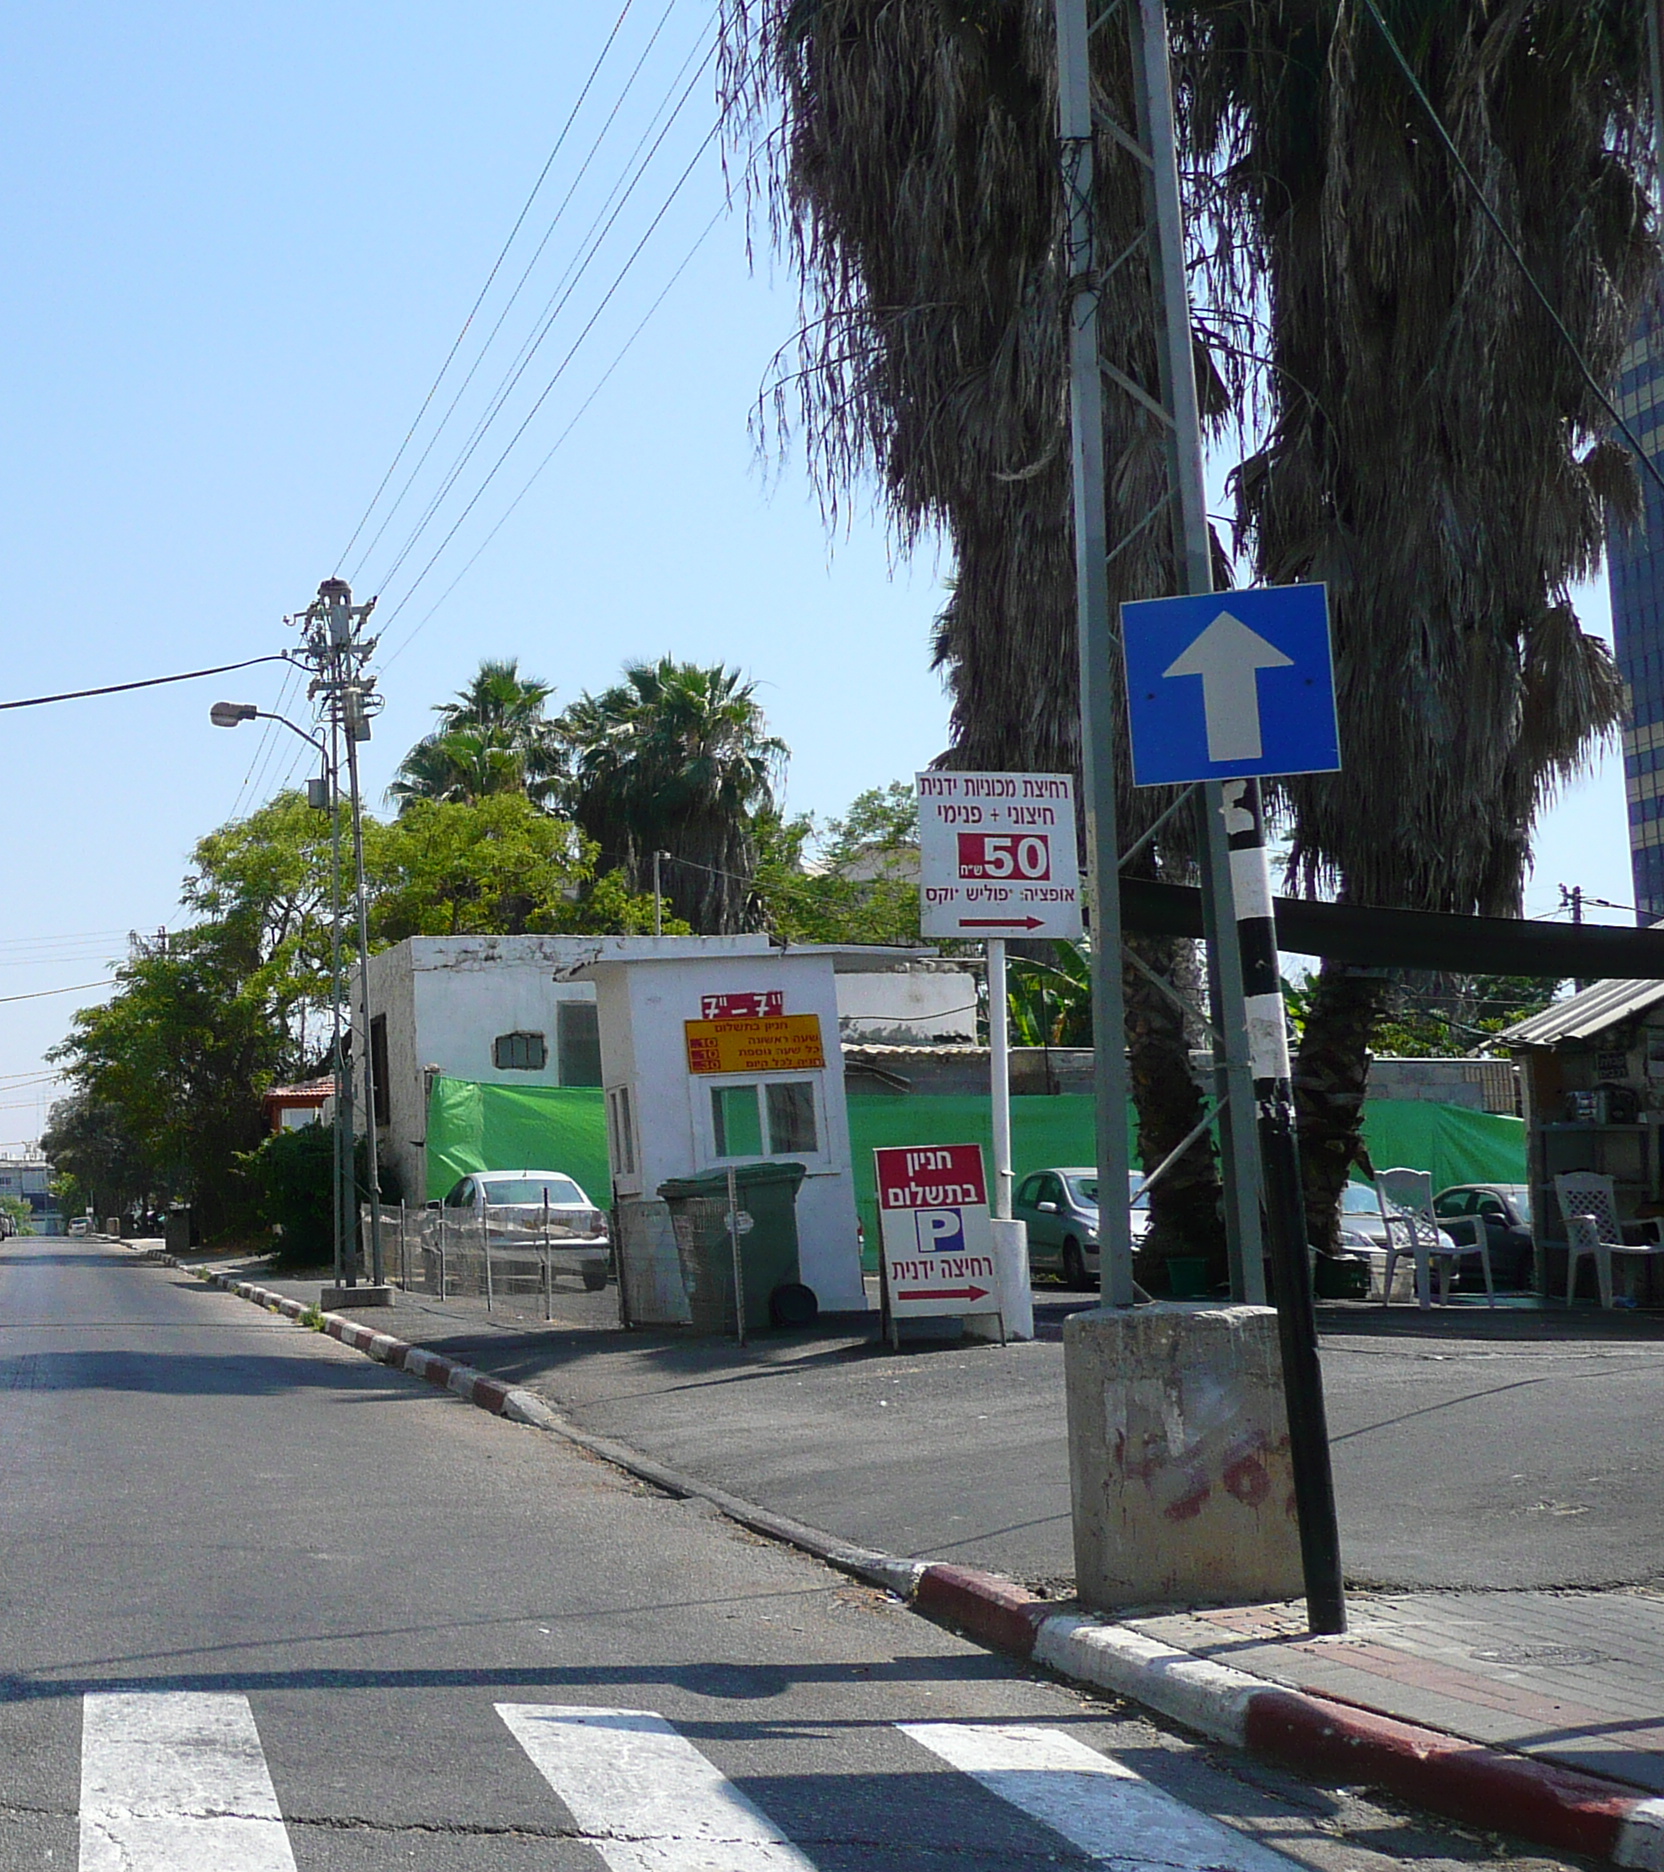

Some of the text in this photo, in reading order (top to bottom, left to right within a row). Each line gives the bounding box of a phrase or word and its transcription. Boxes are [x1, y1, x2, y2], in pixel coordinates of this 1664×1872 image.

[920, 777, 1068, 799] רחיצת מכוניות ידנית
[937, 804, 982, 823] פנימי
[1007, 806, 1055, 825] חיצוני
[984, 837, 1048, 878] 50
[715, 1023, 760, 1033] בתשלום
[906, 1151, 952, 1177] חניון
[887, 1181, 978, 1207] בתשלום
[916, 1210, 961, 1252] P
[891, 1256, 994, 1281] רחיצה ידנית
